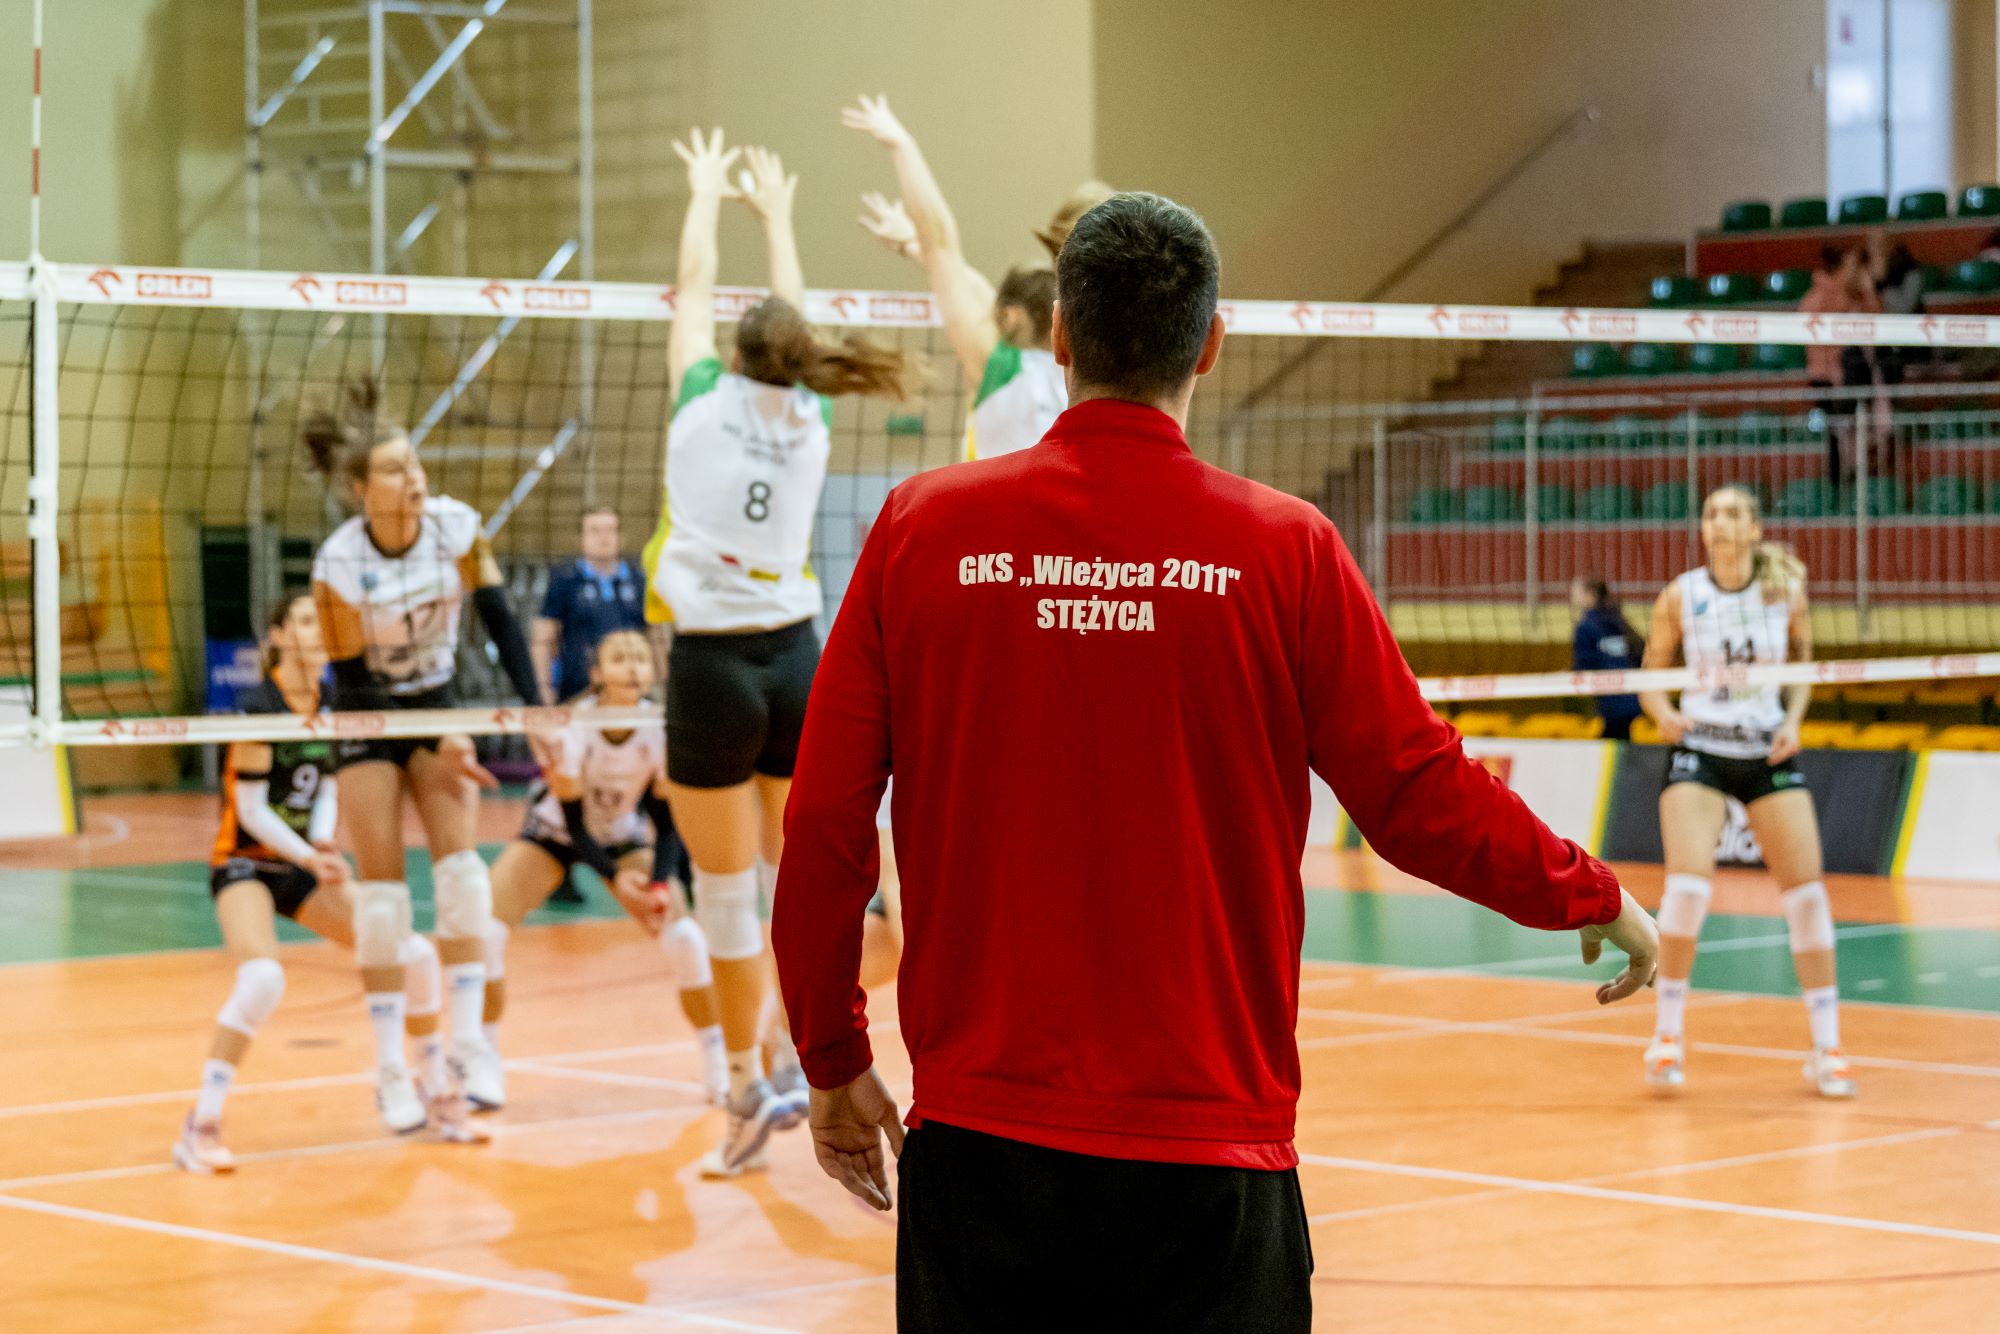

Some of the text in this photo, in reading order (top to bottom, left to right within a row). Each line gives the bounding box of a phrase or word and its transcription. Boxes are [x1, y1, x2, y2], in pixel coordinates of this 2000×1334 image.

[140, 275, 209, 297] ORLEN
[338, 282, 405, 304] ORLEN
[526, 288, 590, 309] ORLEN
[744, 481, 772, 523] 8
[959, 552, 1013, 586] GKS
[1019, 554, 1155, 590] „Wieżyca
[1037, 595, 1155, 635] STĘŻYCA
[1724, 638, 1755, 665] 14
[288, 764, 319, 809] 9
